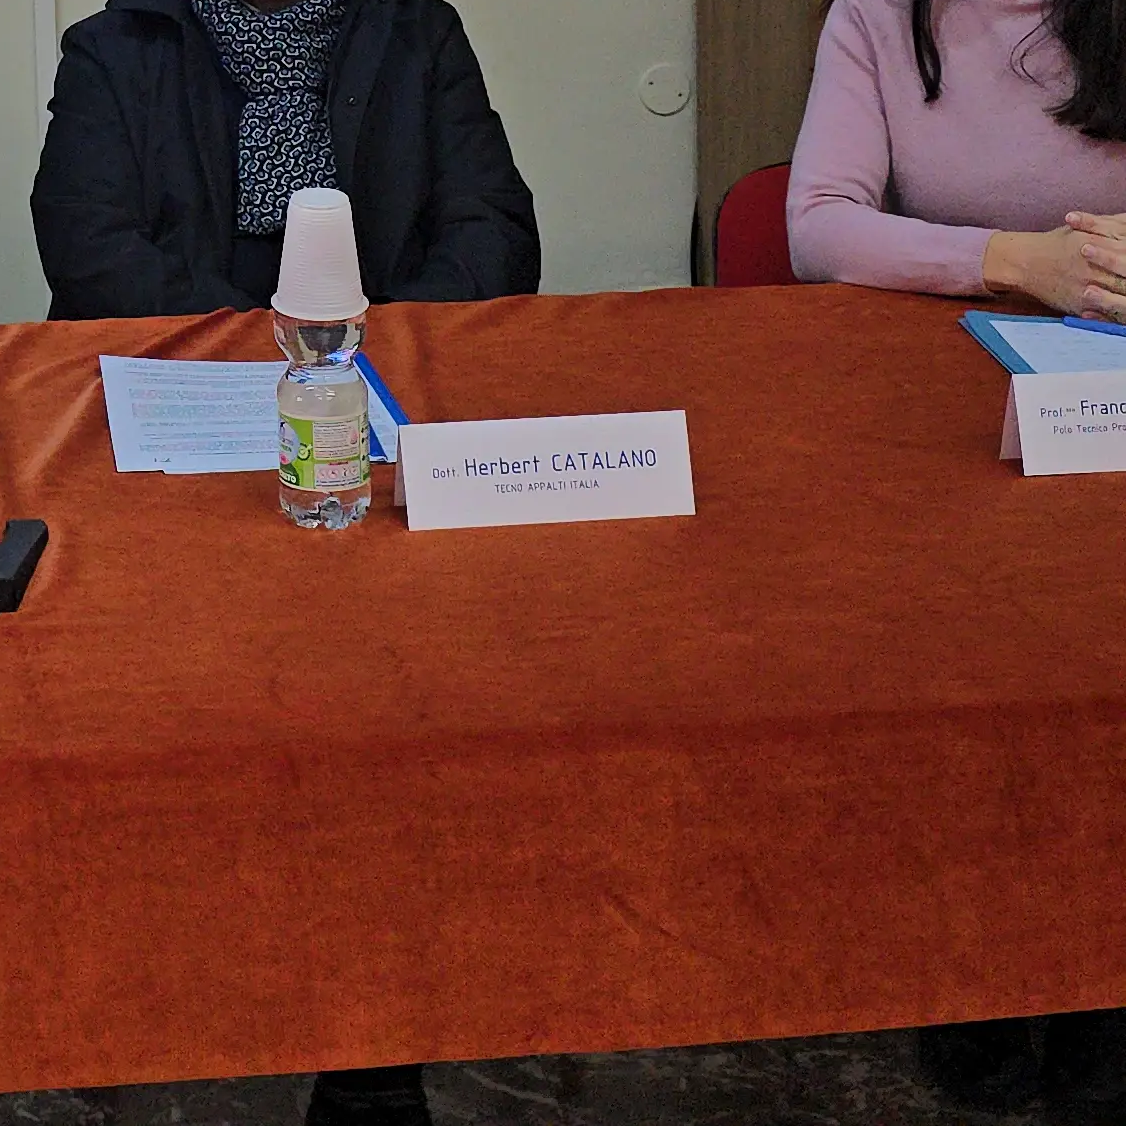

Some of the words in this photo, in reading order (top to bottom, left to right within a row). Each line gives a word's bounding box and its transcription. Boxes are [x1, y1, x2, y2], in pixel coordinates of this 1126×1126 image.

[1054, 425, 1073, 435] Polo
[1076, 424, 1108, 433] Tecnico
[432, 466, 461, 479] Dott.
[465, 456, 541, 477] Herbert
[551, 449, 657, 473] CATALANO
[495, 482, 523, 494] TECNO
[528, 480, 567, 492] APPALTI
[570, 479, 600, 490] ITALIA
